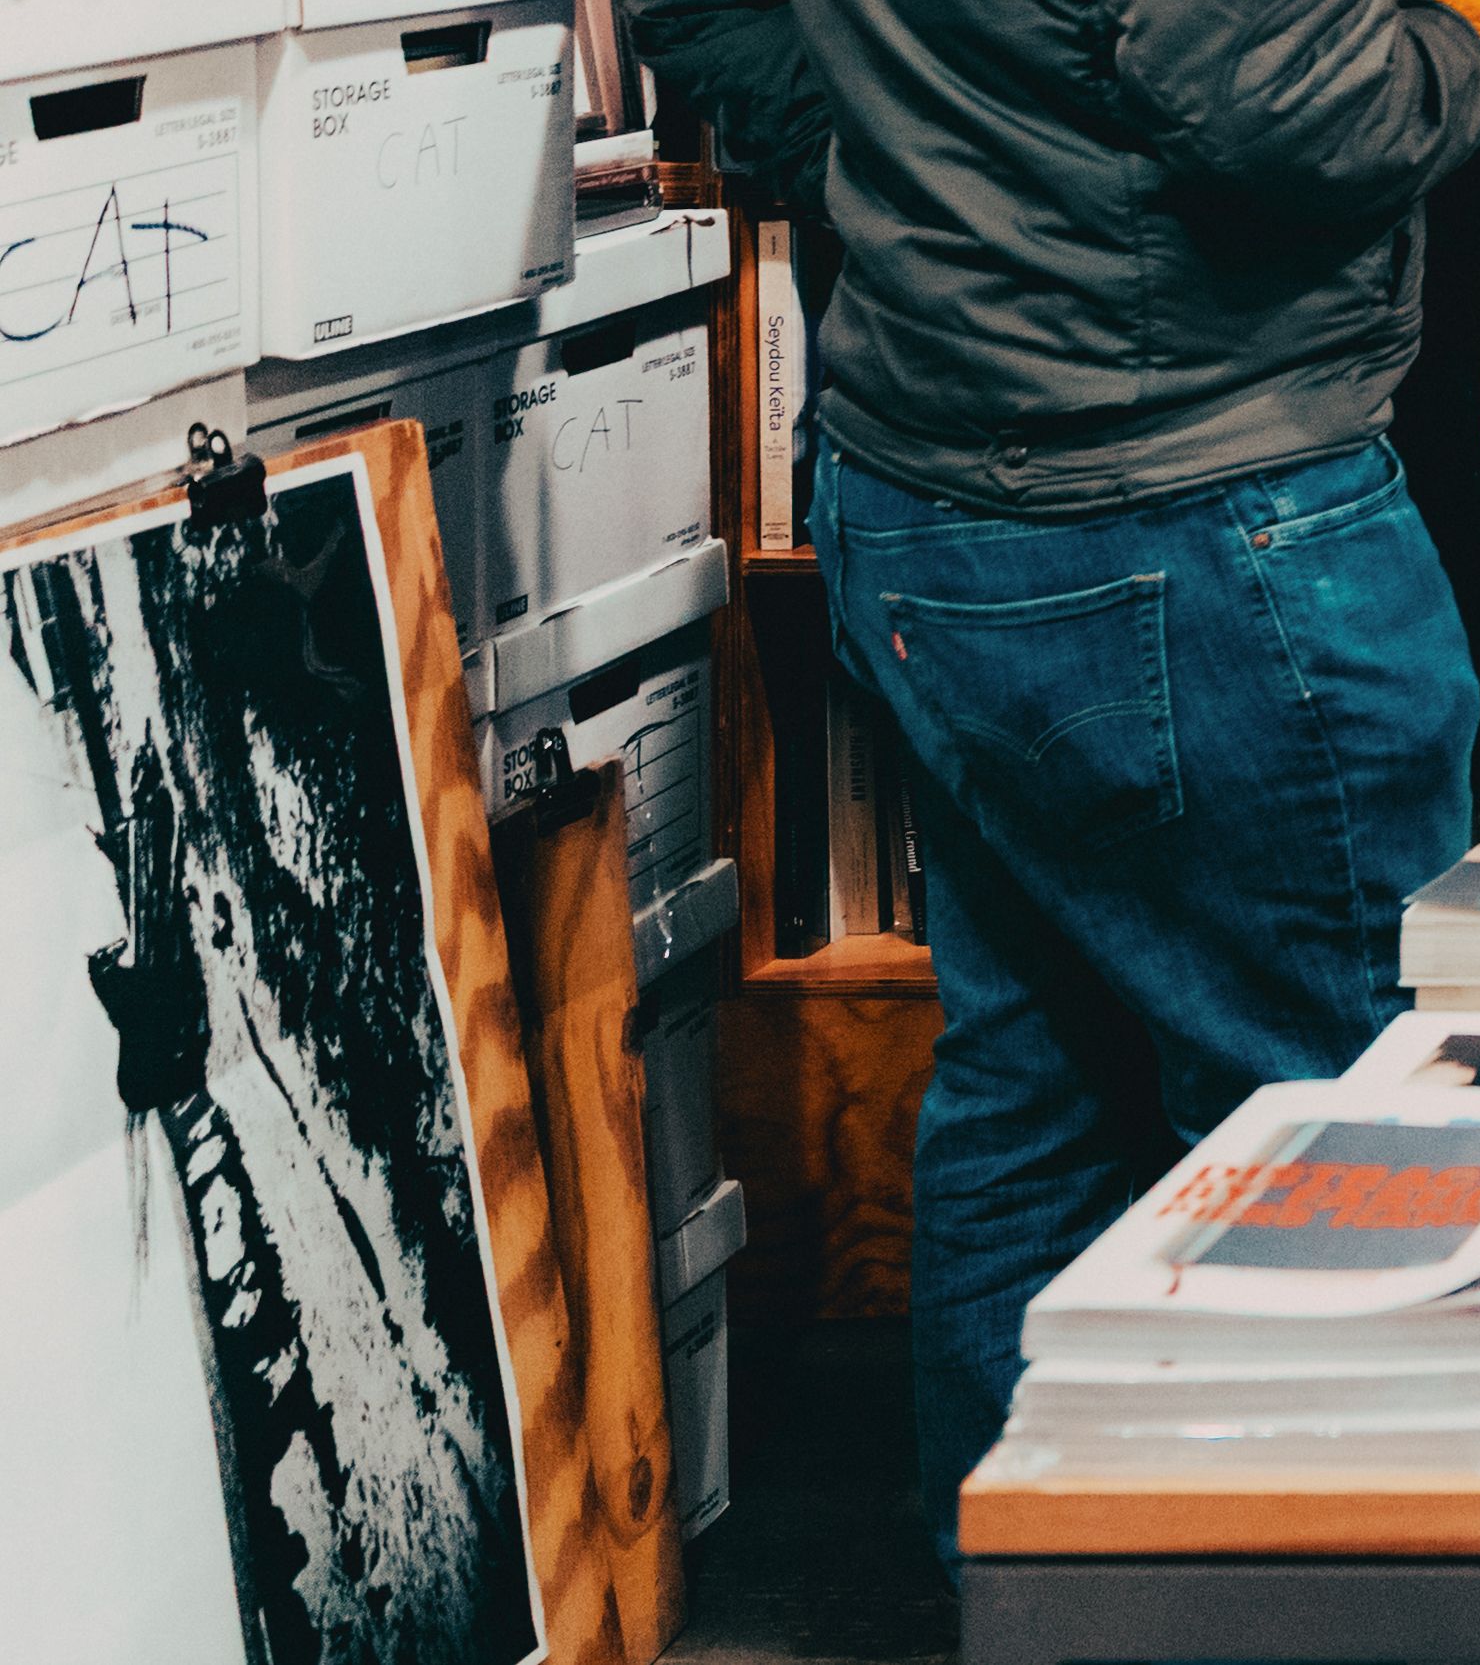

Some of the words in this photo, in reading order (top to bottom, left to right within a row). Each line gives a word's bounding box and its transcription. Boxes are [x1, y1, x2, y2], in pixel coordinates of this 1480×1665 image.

[312, 79, 392, 111] STORAGE
[312, 113, 349, 139] BOX
[379, 116, 468, 189] CAT
[765, 315, 786, 381] Seydou
[553, 399, 642, 473] CAT
[767, 387, 787, 431] Keïta
